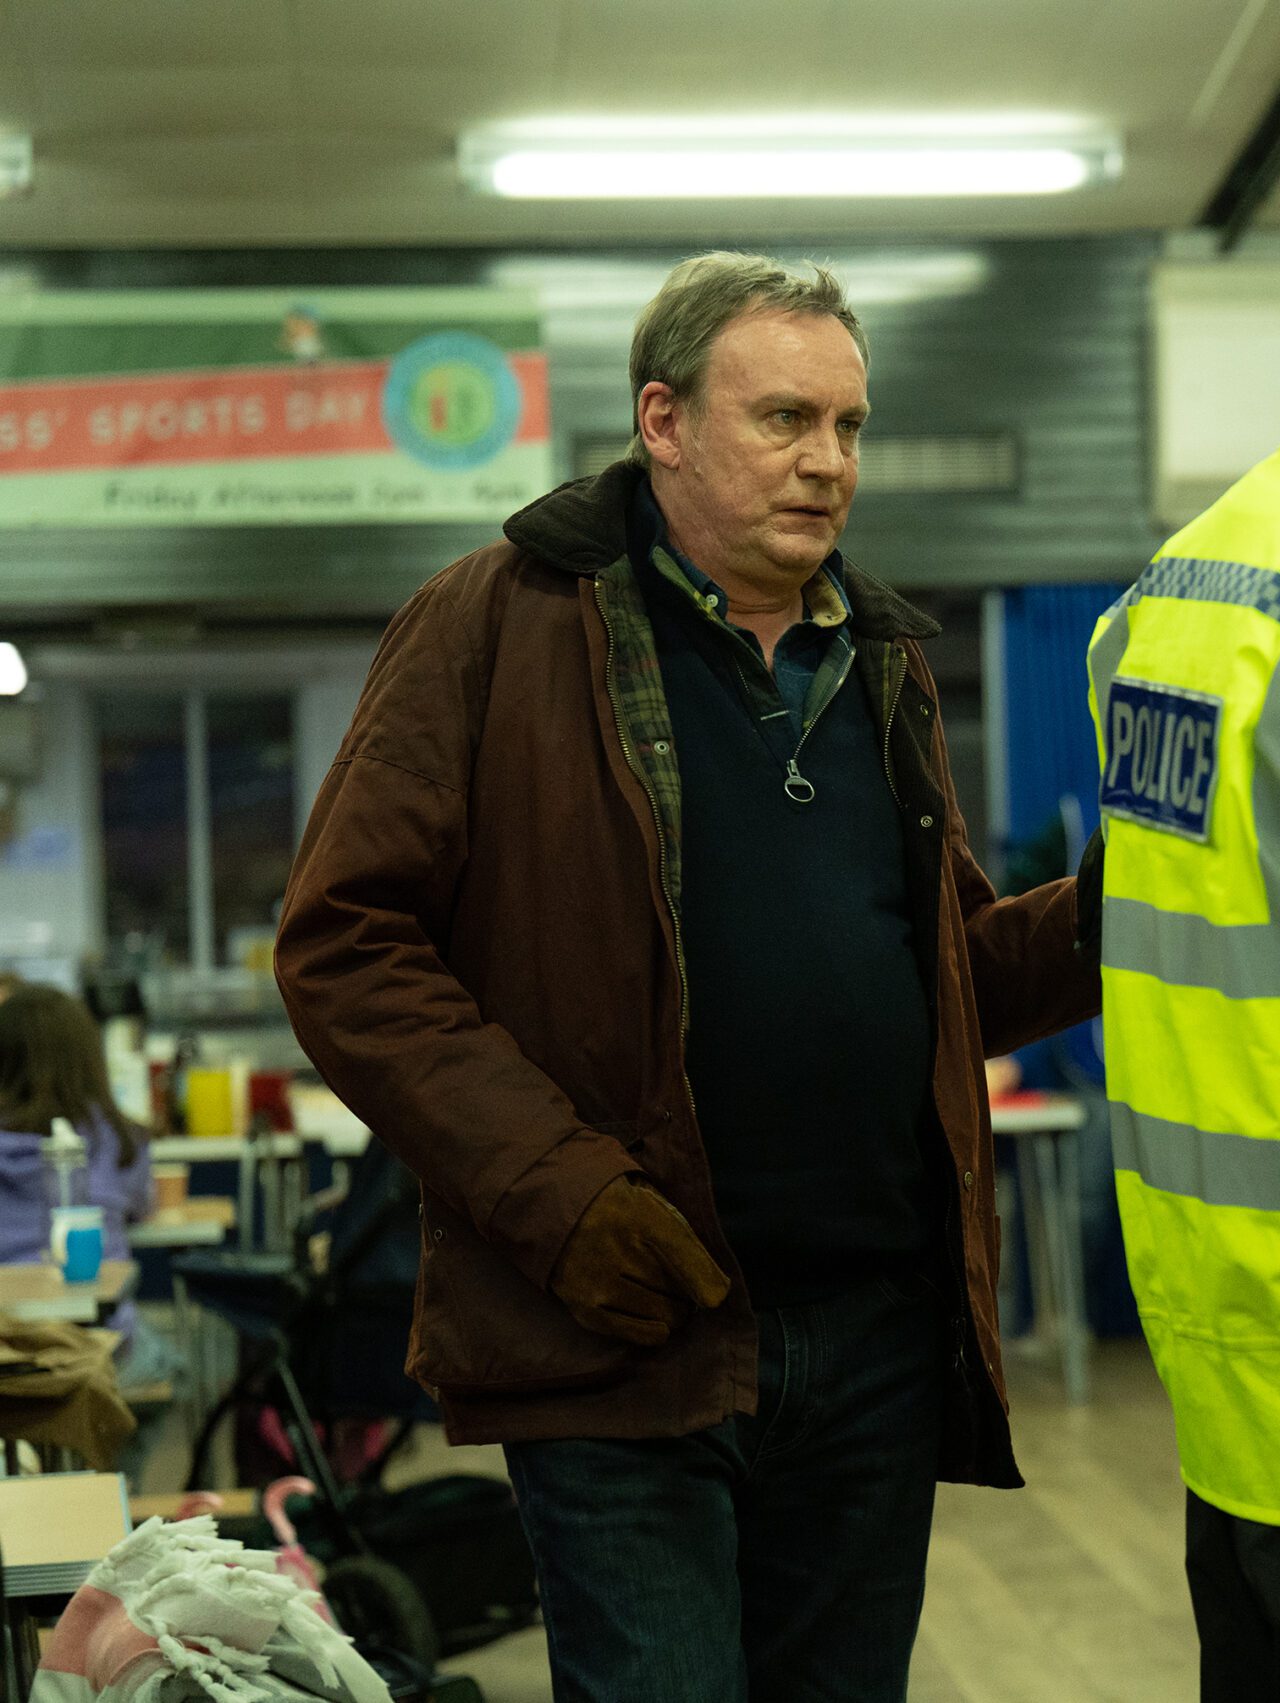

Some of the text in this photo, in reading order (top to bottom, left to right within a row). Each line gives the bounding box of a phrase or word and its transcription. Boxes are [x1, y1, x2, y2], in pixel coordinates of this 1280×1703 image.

[89, 394, 267, 447] SPORTS
[285, 389, 367, 432] DAY
[1106, 701, 1212, 815] POLICE
